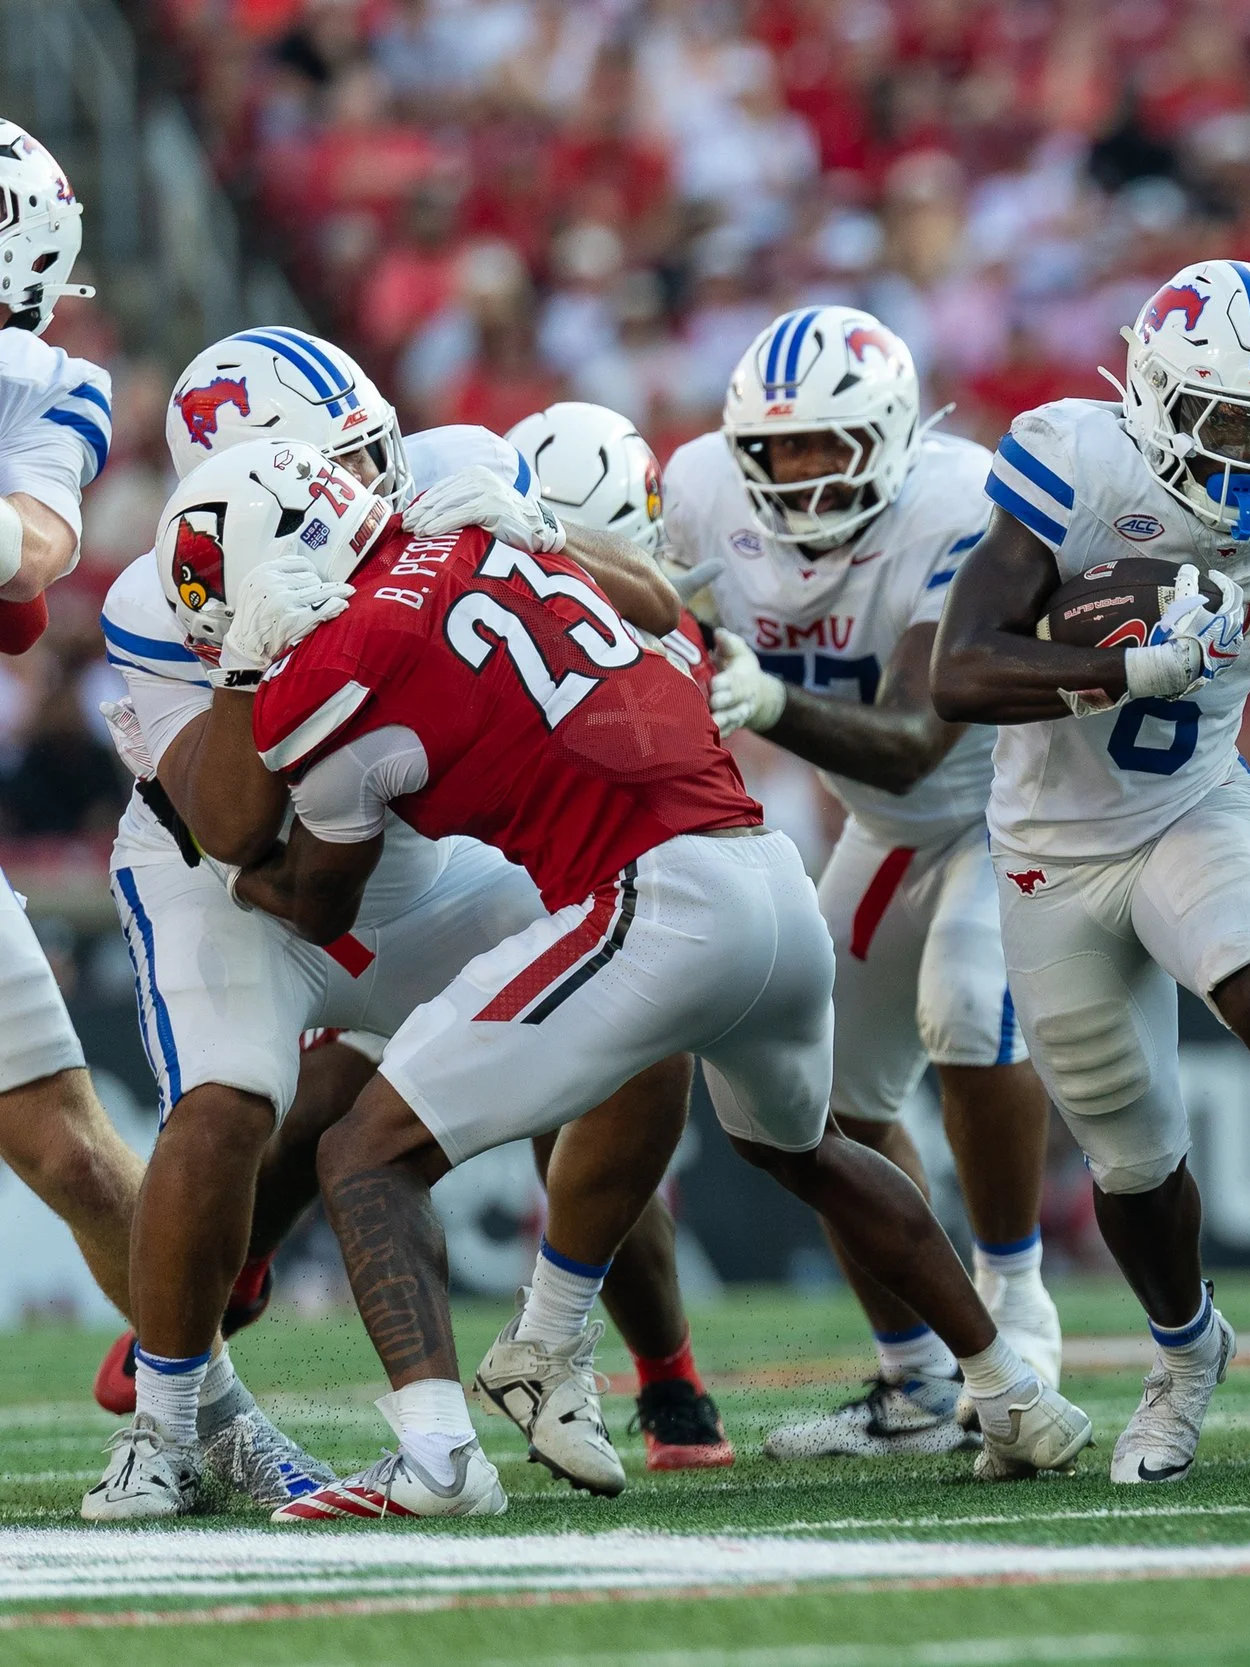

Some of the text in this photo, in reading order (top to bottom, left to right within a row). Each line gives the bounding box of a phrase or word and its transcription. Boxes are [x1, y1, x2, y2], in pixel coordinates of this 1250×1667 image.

[341, 408, 368, 431] ACC
[308, 467, 356, 519] 23
[302, 521, 321, 541] USA
[307, 526, 329, 549] 250
[1119, 519, 1158, 535] ACC
[373, 586, 431, 610] B.
[443, 538, 643, 736] 23
[756, 615, 855, 651] SMU
